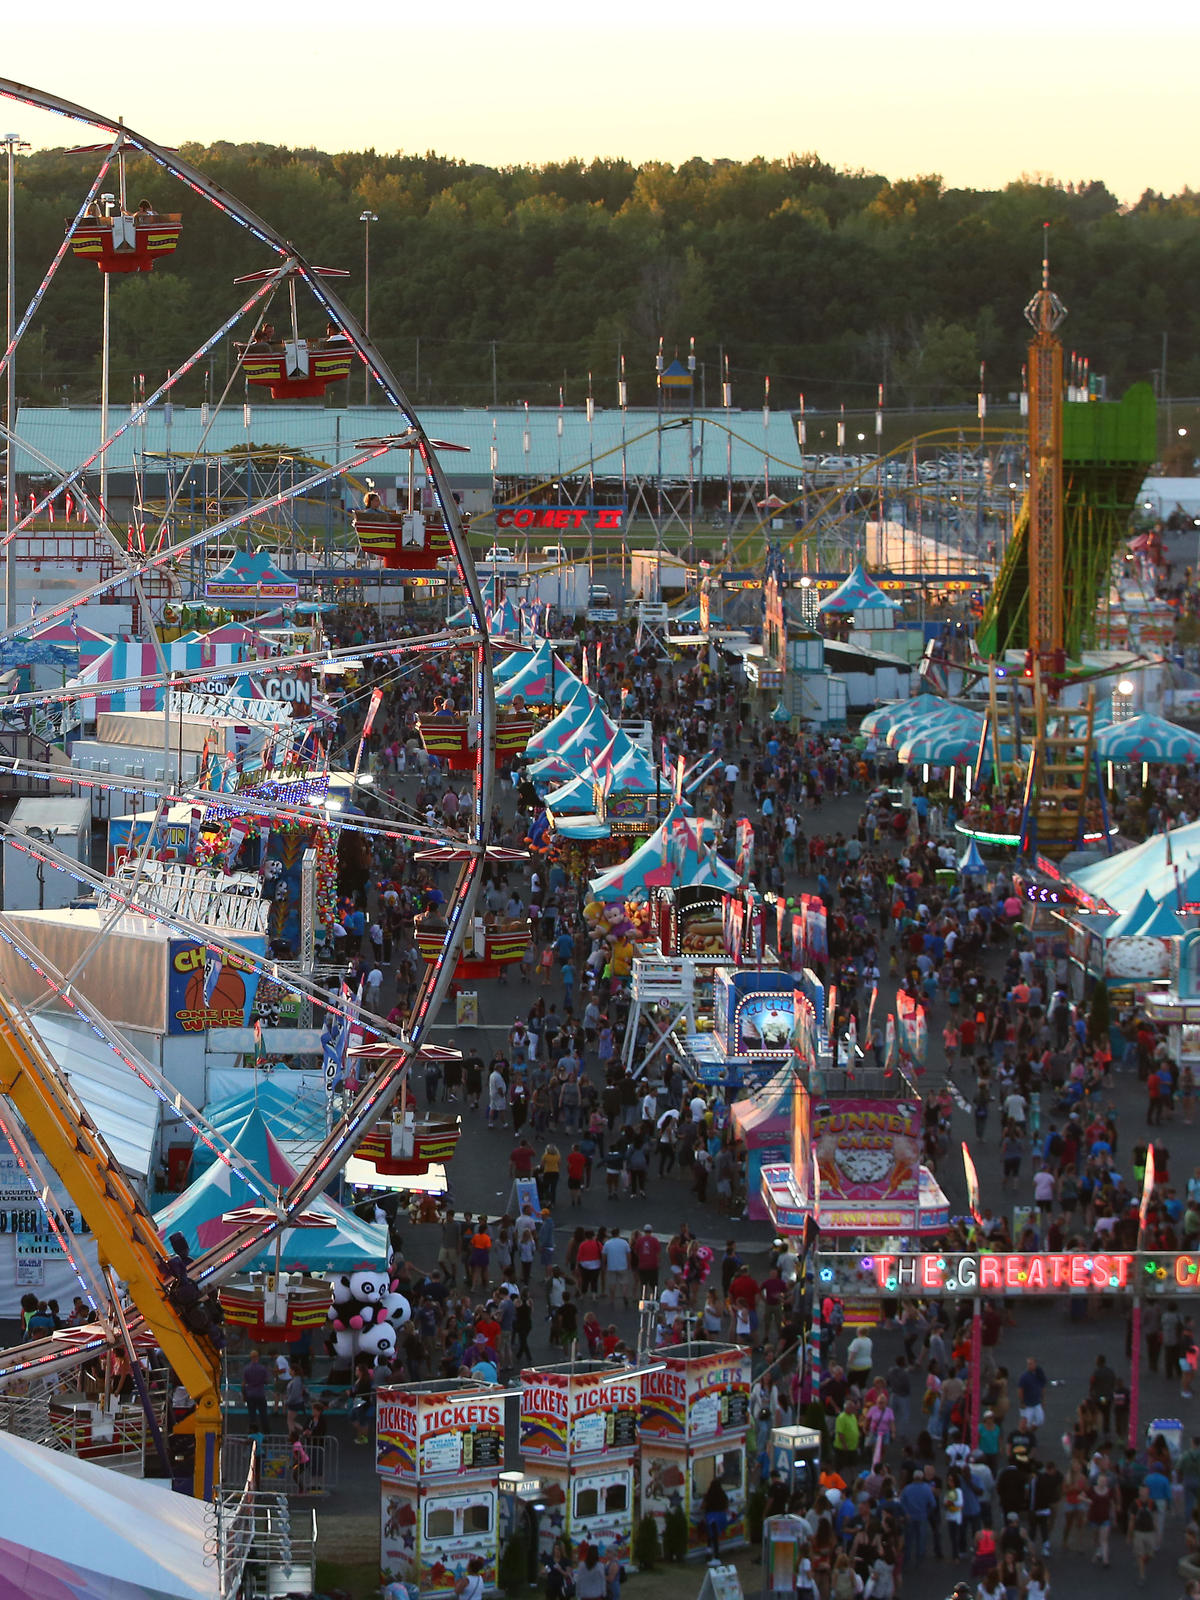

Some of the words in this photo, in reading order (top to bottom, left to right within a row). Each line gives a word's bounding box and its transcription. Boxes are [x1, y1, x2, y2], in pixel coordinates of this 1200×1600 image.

[496, 509, 588, 528] COMET
[594, 510, 623, 528] II
[259, 678, 310, 704] CON
[174, 946, 257, 974] CHICE
[176, 1009, 218, 1020] ONE
[223, 1009, 244, 1019] IN
[812, 1111, 918, 1140] FUNNEL
[837, 1135, 894, 1150] CAKES
[11, 1209, 37, 1232] BEER
[874, 1255, 943, 1287] THE
[957, 1255, 1133, 1287] GREATEST
[1175, 1255, 1200, 1287] C
[640, 1372, 687, 1401] TICKETS
[695, 1367, 743, 1390] TICKETS
[522, 1388, 568, 1418] TICKETS
[574, 1386, 638, 1412] TICKETS
[379, 1406, 417, 1437] TICKETS
[423, 1405, 500, 1432] TICKETS
[500, 1481, 511, 1490] TM
[520, 1480, 540, 1491] ATM
